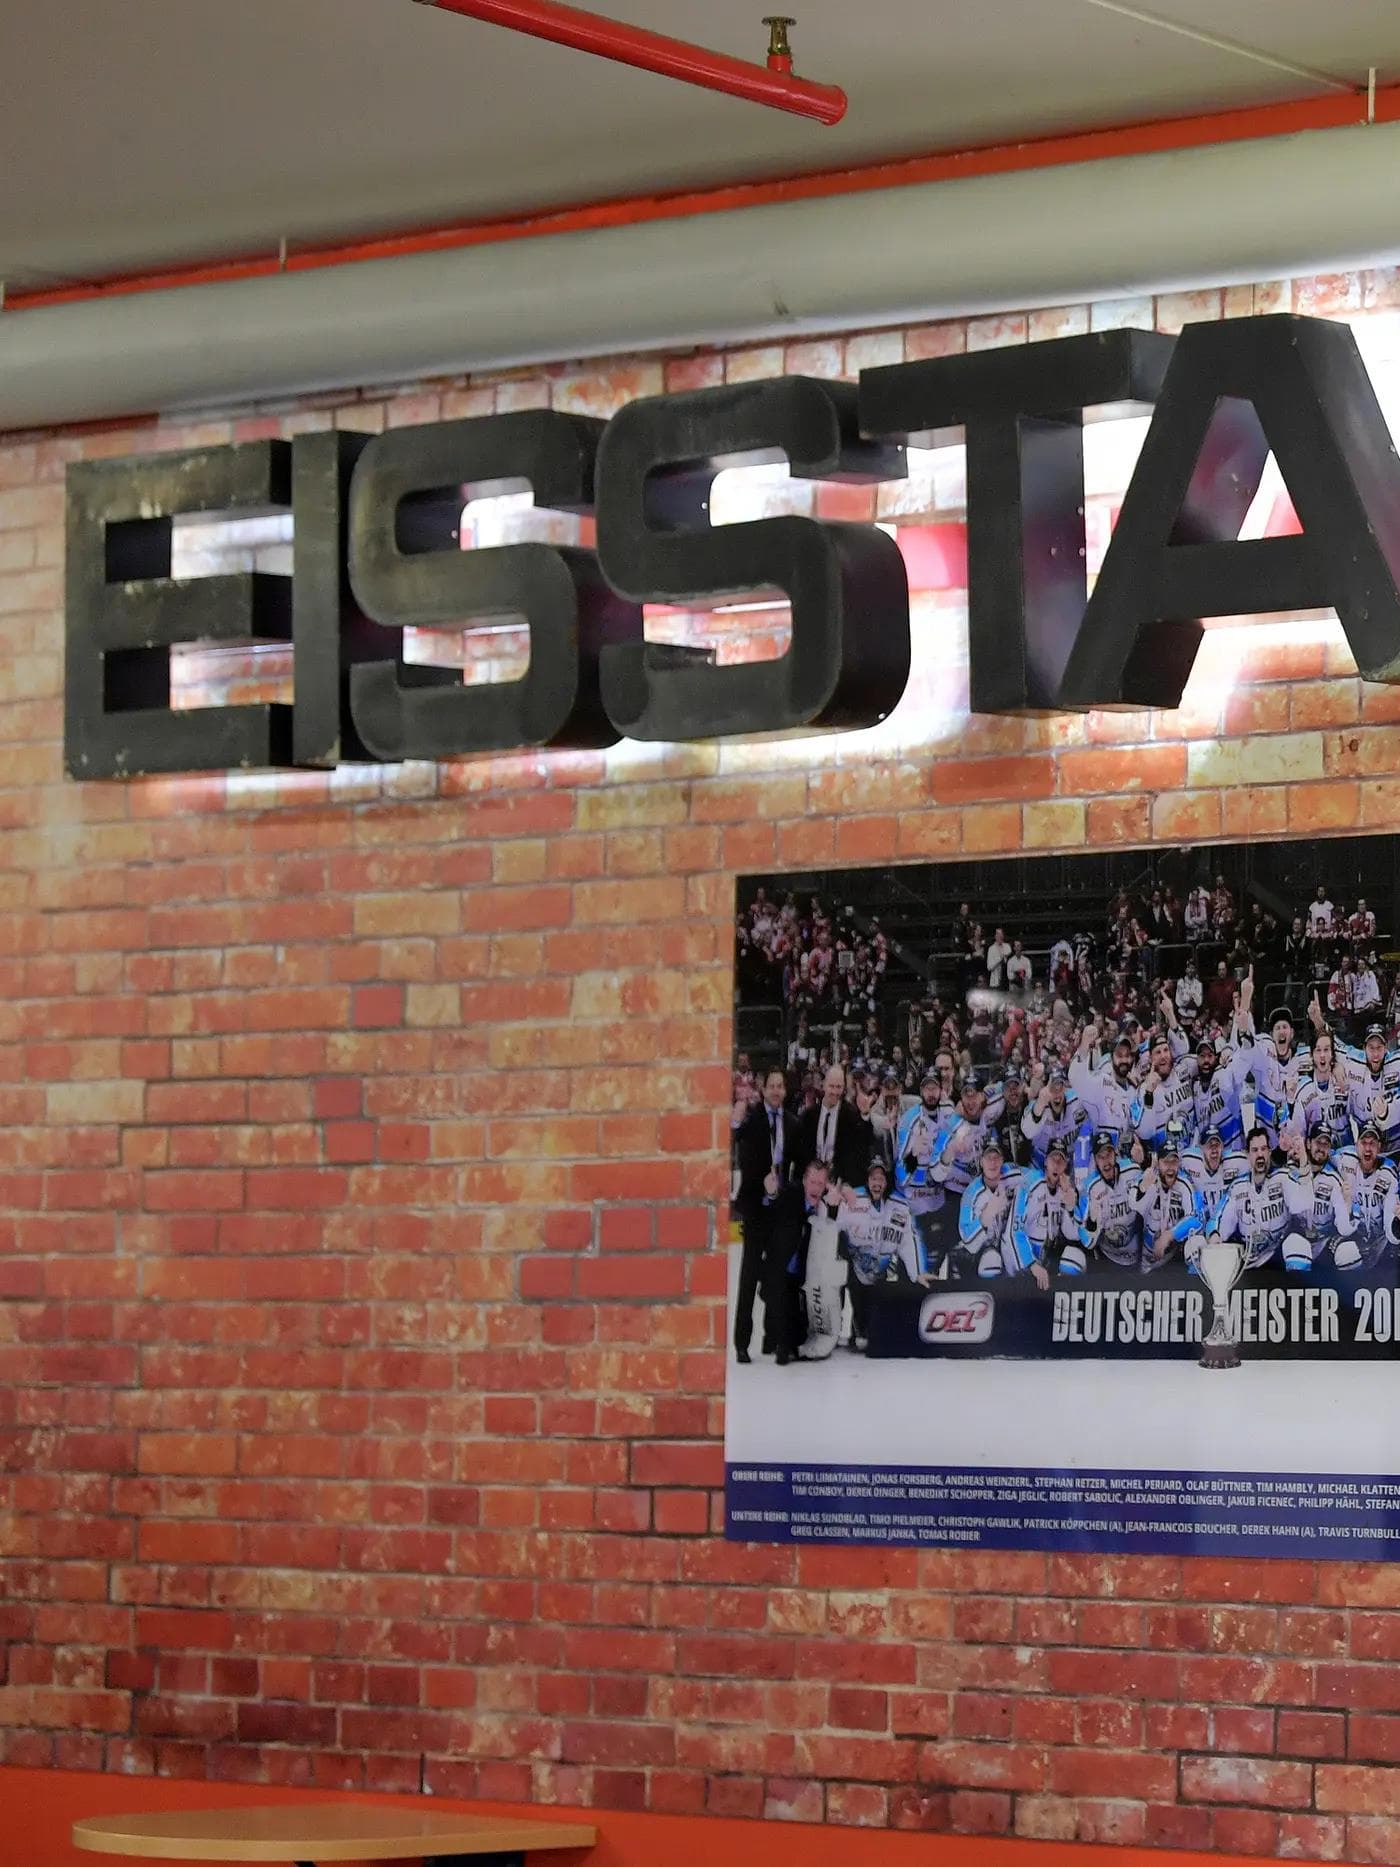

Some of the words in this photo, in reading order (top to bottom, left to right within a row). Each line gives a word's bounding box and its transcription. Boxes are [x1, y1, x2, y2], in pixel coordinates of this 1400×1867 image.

[925, 1307, 984, 1334] DEL
[1052, 1290, 1202, 1343] DEUTSCHER
[985, 1476, 1032, 1490] WEINZIERL,
[1034, 1477, 1074, 1489] STEPHAN
[1075, 1478, 1108, 1492] RETZER,
[1110, 1478, 1142, 1491] MICHEL
[1144, 1479, 1184, 1493] PERIARD,
[1186, 1480, 1209, 1492] OLAF
[1210, 1479, 1254, 1495] BÜTTNER,
[1256, 1482, 1274, 1494] TIM
[1275, 1482, 1316, 1496] HAMBLY,
[1318, 1483, 1358, 1495] MICHAEL
[1049, 1491, 1084, 1503] ROBERT
[1084, 1492, 1124, 1506] SABOLIC,
[1124, 1493, 1177, 1505] ALEXANDER
[1178, 1494, 1226, 1508] OBLINGER,
[1226, 1495, 1256, 1509] JAKUB
[1257, 1496, 1296, 1510] FICENEC,
[1298, 1497, 1334, 1509] PHILIPP
[1365, 1499, 1400, 1511] STEFAN
[1023, 1518, 1060, 1531] PATRICK
[1060, 1517, 1108, 1532] KÖPPCHEN
[1194, 1523, 1240, 1537] BOUCHER,
[1241, 1524, 1270, 1536] DEREK
[1271, 1525, 1299, 1537] HAHN
[1318, 1526, 1350, 1538] TRAVIS
